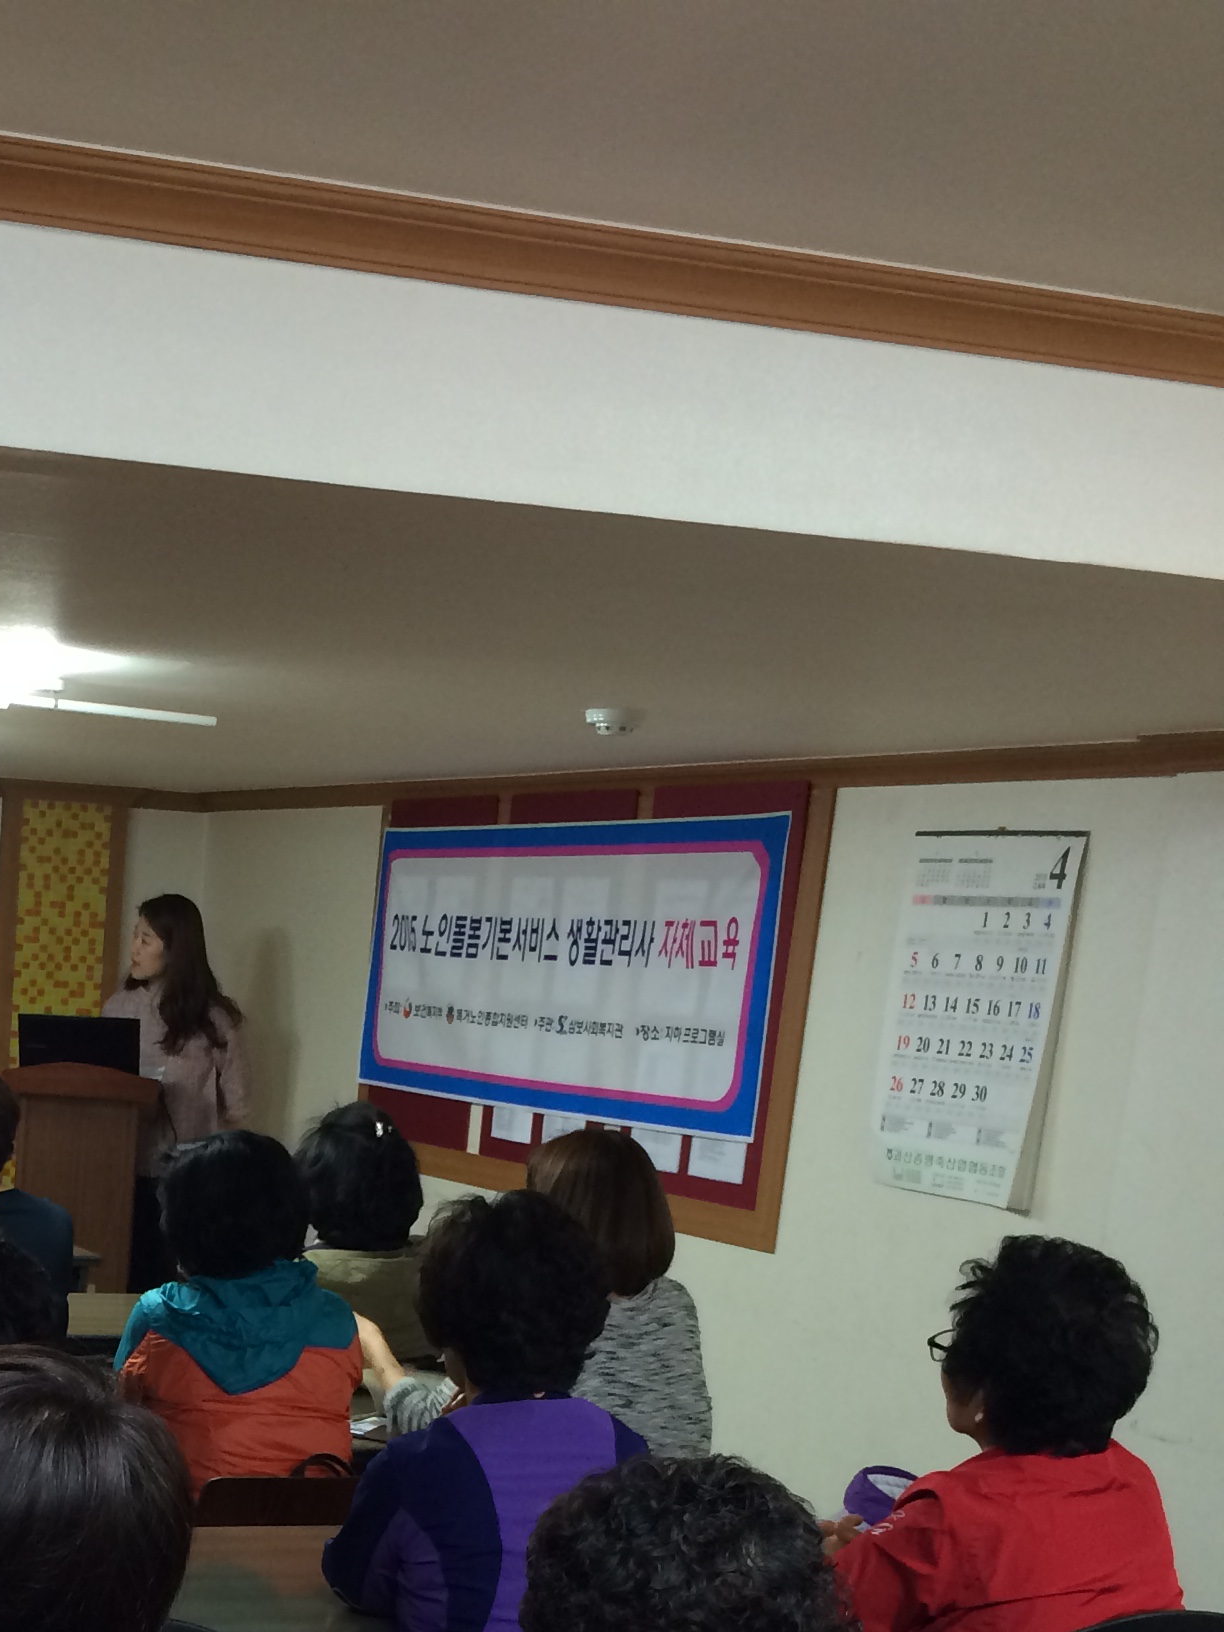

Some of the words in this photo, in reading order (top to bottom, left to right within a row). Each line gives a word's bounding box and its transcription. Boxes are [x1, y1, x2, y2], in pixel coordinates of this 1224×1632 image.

[1048, 846, 1071, 890] 4
[981, 911, 989, 928] 1
[1002, 911, 1011, 929] 2
[1022, 911, 1031, 929] 3
[389, 913, 418, 952] 2015
[419, 913, 560, 964] 노인돌봄기본서비스
[566, 917, 657, 969] 생활관리사
[910, 951, 919, 968] 5
[931, 952, 940, 969] 6
[953, 953, 962, 970] 7
[974, 954, 984, 972] 8
[996, 955, 1005, 972] 9
[1013, 956, 1028, 974] 10
[1035, 957, 1047, 975] 11
[902, 993, 917, 1010] 12
[923, 994, 937, 1011] 13
[943, 995, 959, 1013] 14
[965, 997, 981, 1015] 15
[986, 999, 1001, 1016] 16
[1007, 1000, 1022, 1018] 17
[1027, 1002, 1041, 1020] 18
[896, 1034, 911, 1051] 19
[915, 1036, 931, 1053] 20
[936, 1038, 950, 1055] 21
[957, 1040, 973, 1057] 22
[979, 1042, 994, 1060] 23
[999, 1043, 1014, 1062] 24
[1018, 1046, 1034, 1064] 25
[889, 1075, 904, 1093] 26
[909, 1077, 925, 1095] 27
[930, 1079, 945, 1098] 28
[951, 1082, 967, 1100] 29
[971, 1084, 987, 1103] 30
